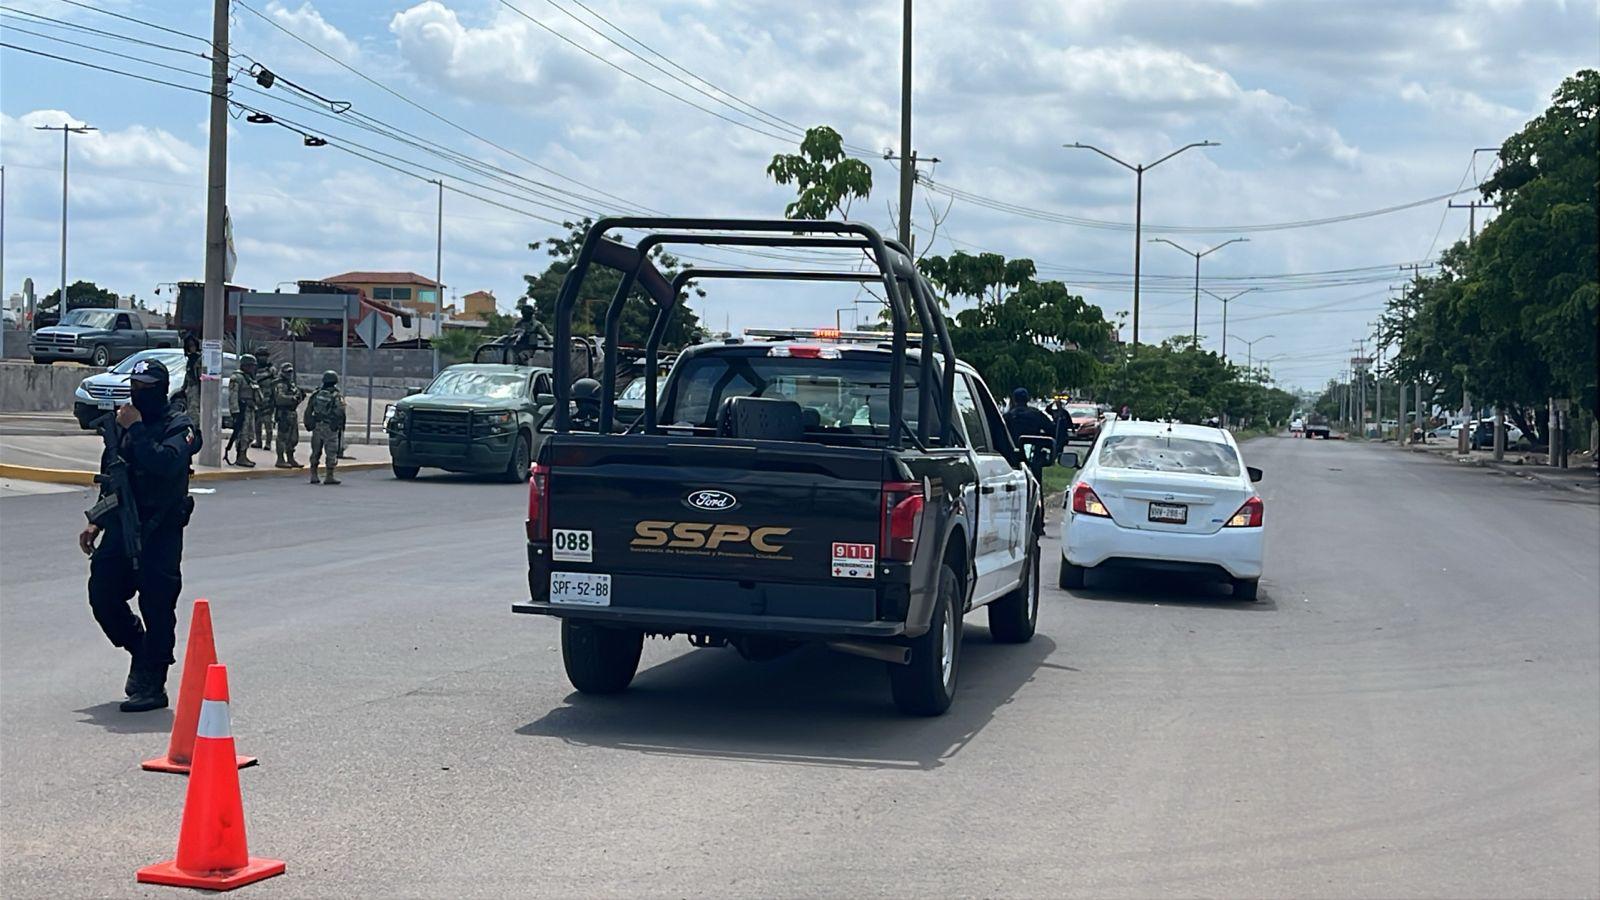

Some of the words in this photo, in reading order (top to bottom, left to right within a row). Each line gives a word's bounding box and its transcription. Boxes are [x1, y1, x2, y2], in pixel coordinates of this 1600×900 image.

[696, 492, 728, 507] Ford
[555, 532, 589, 551] 088
[630, 520, 792, 553] SSPC
[836, 546, 870, 558] 911
[552, 580, 609, 597] SPF-52-B8
